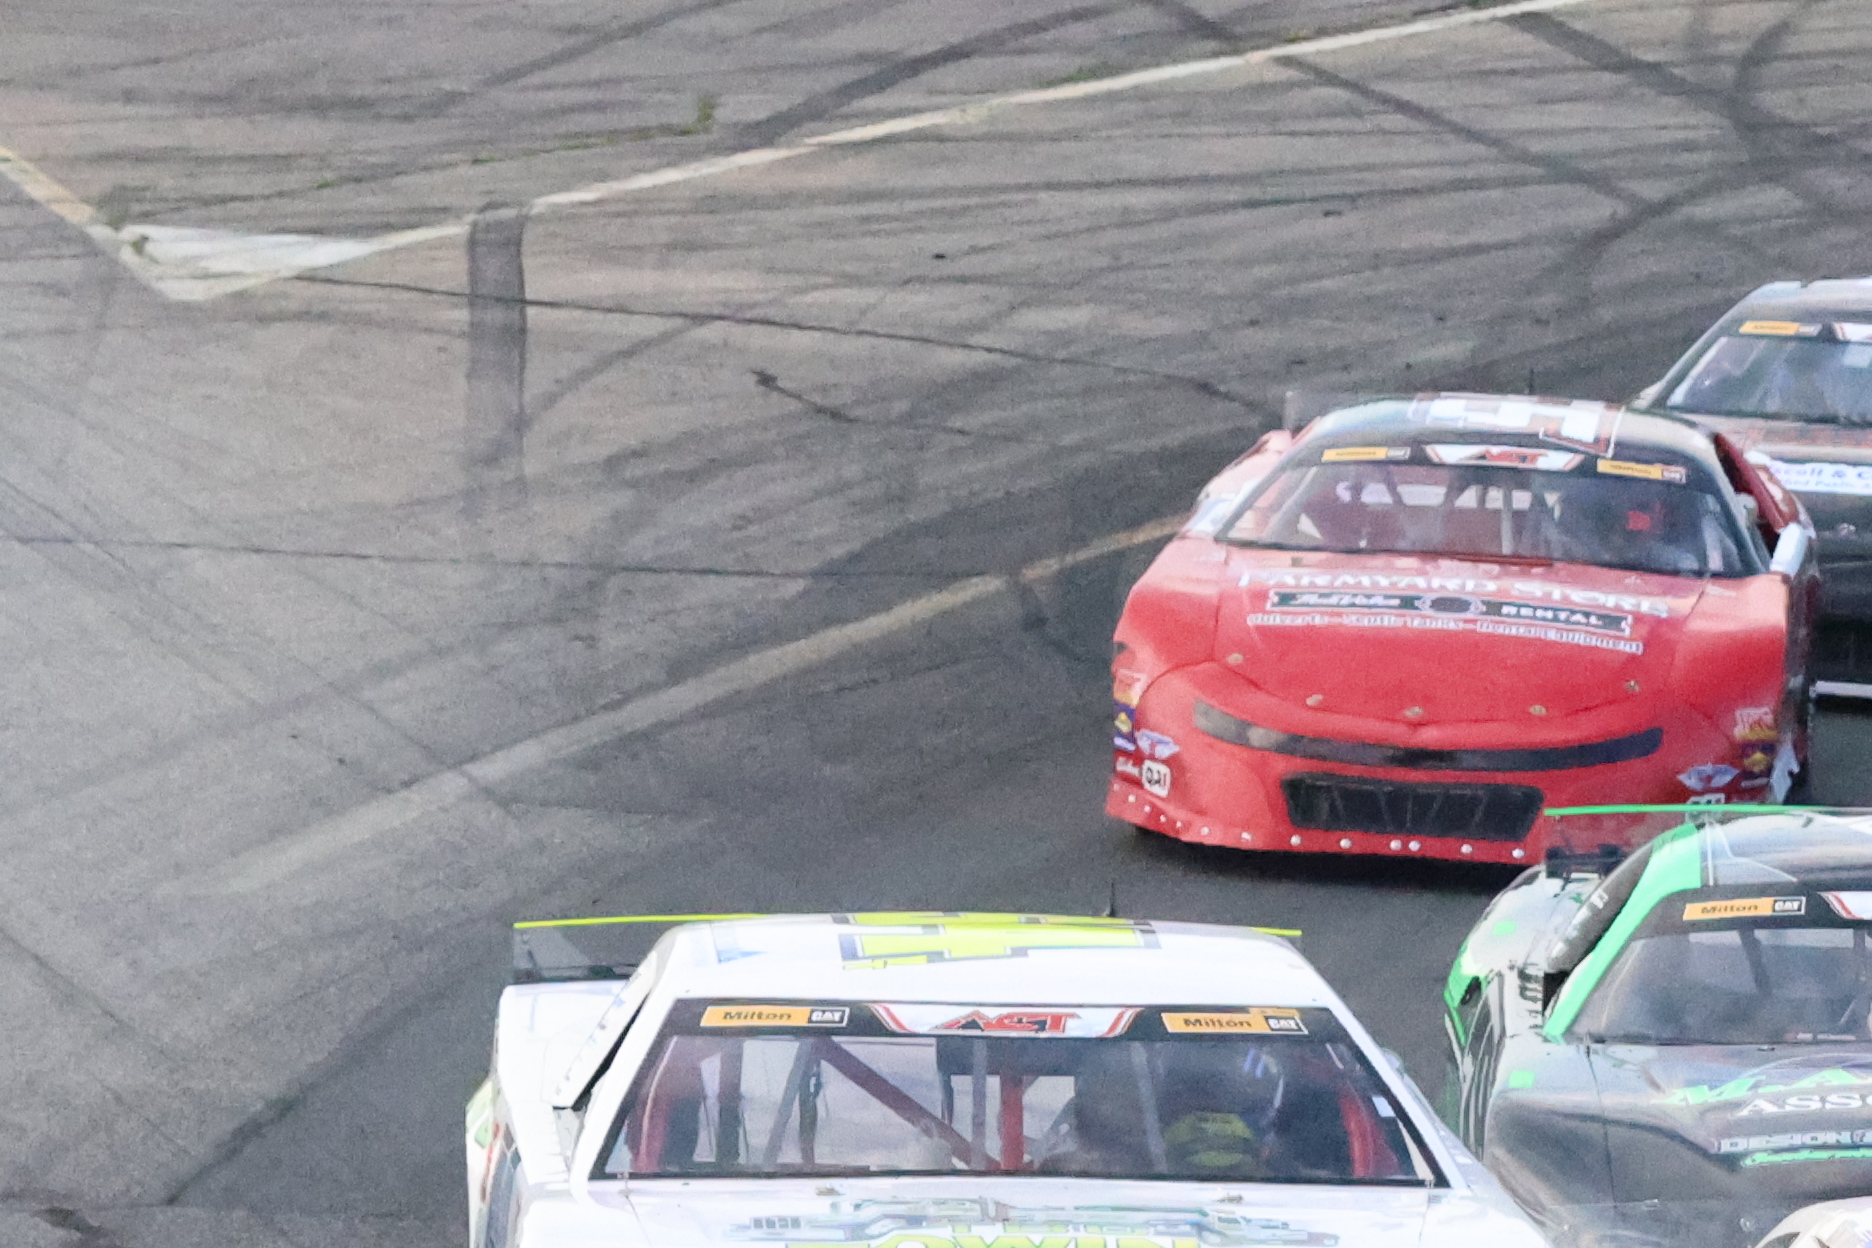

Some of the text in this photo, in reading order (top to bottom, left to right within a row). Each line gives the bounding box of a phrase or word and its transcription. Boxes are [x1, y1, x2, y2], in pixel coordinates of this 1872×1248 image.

[1501, 605, 1603, 625] RENTAL
[1700, 900, 1801, 914] Milton CAT
[722, 1010, 844, 1022] Milton CAT
[930, 1010, 1083, 1034] ACT
[1182, 1016, 1298, 1031] Milton CAT
